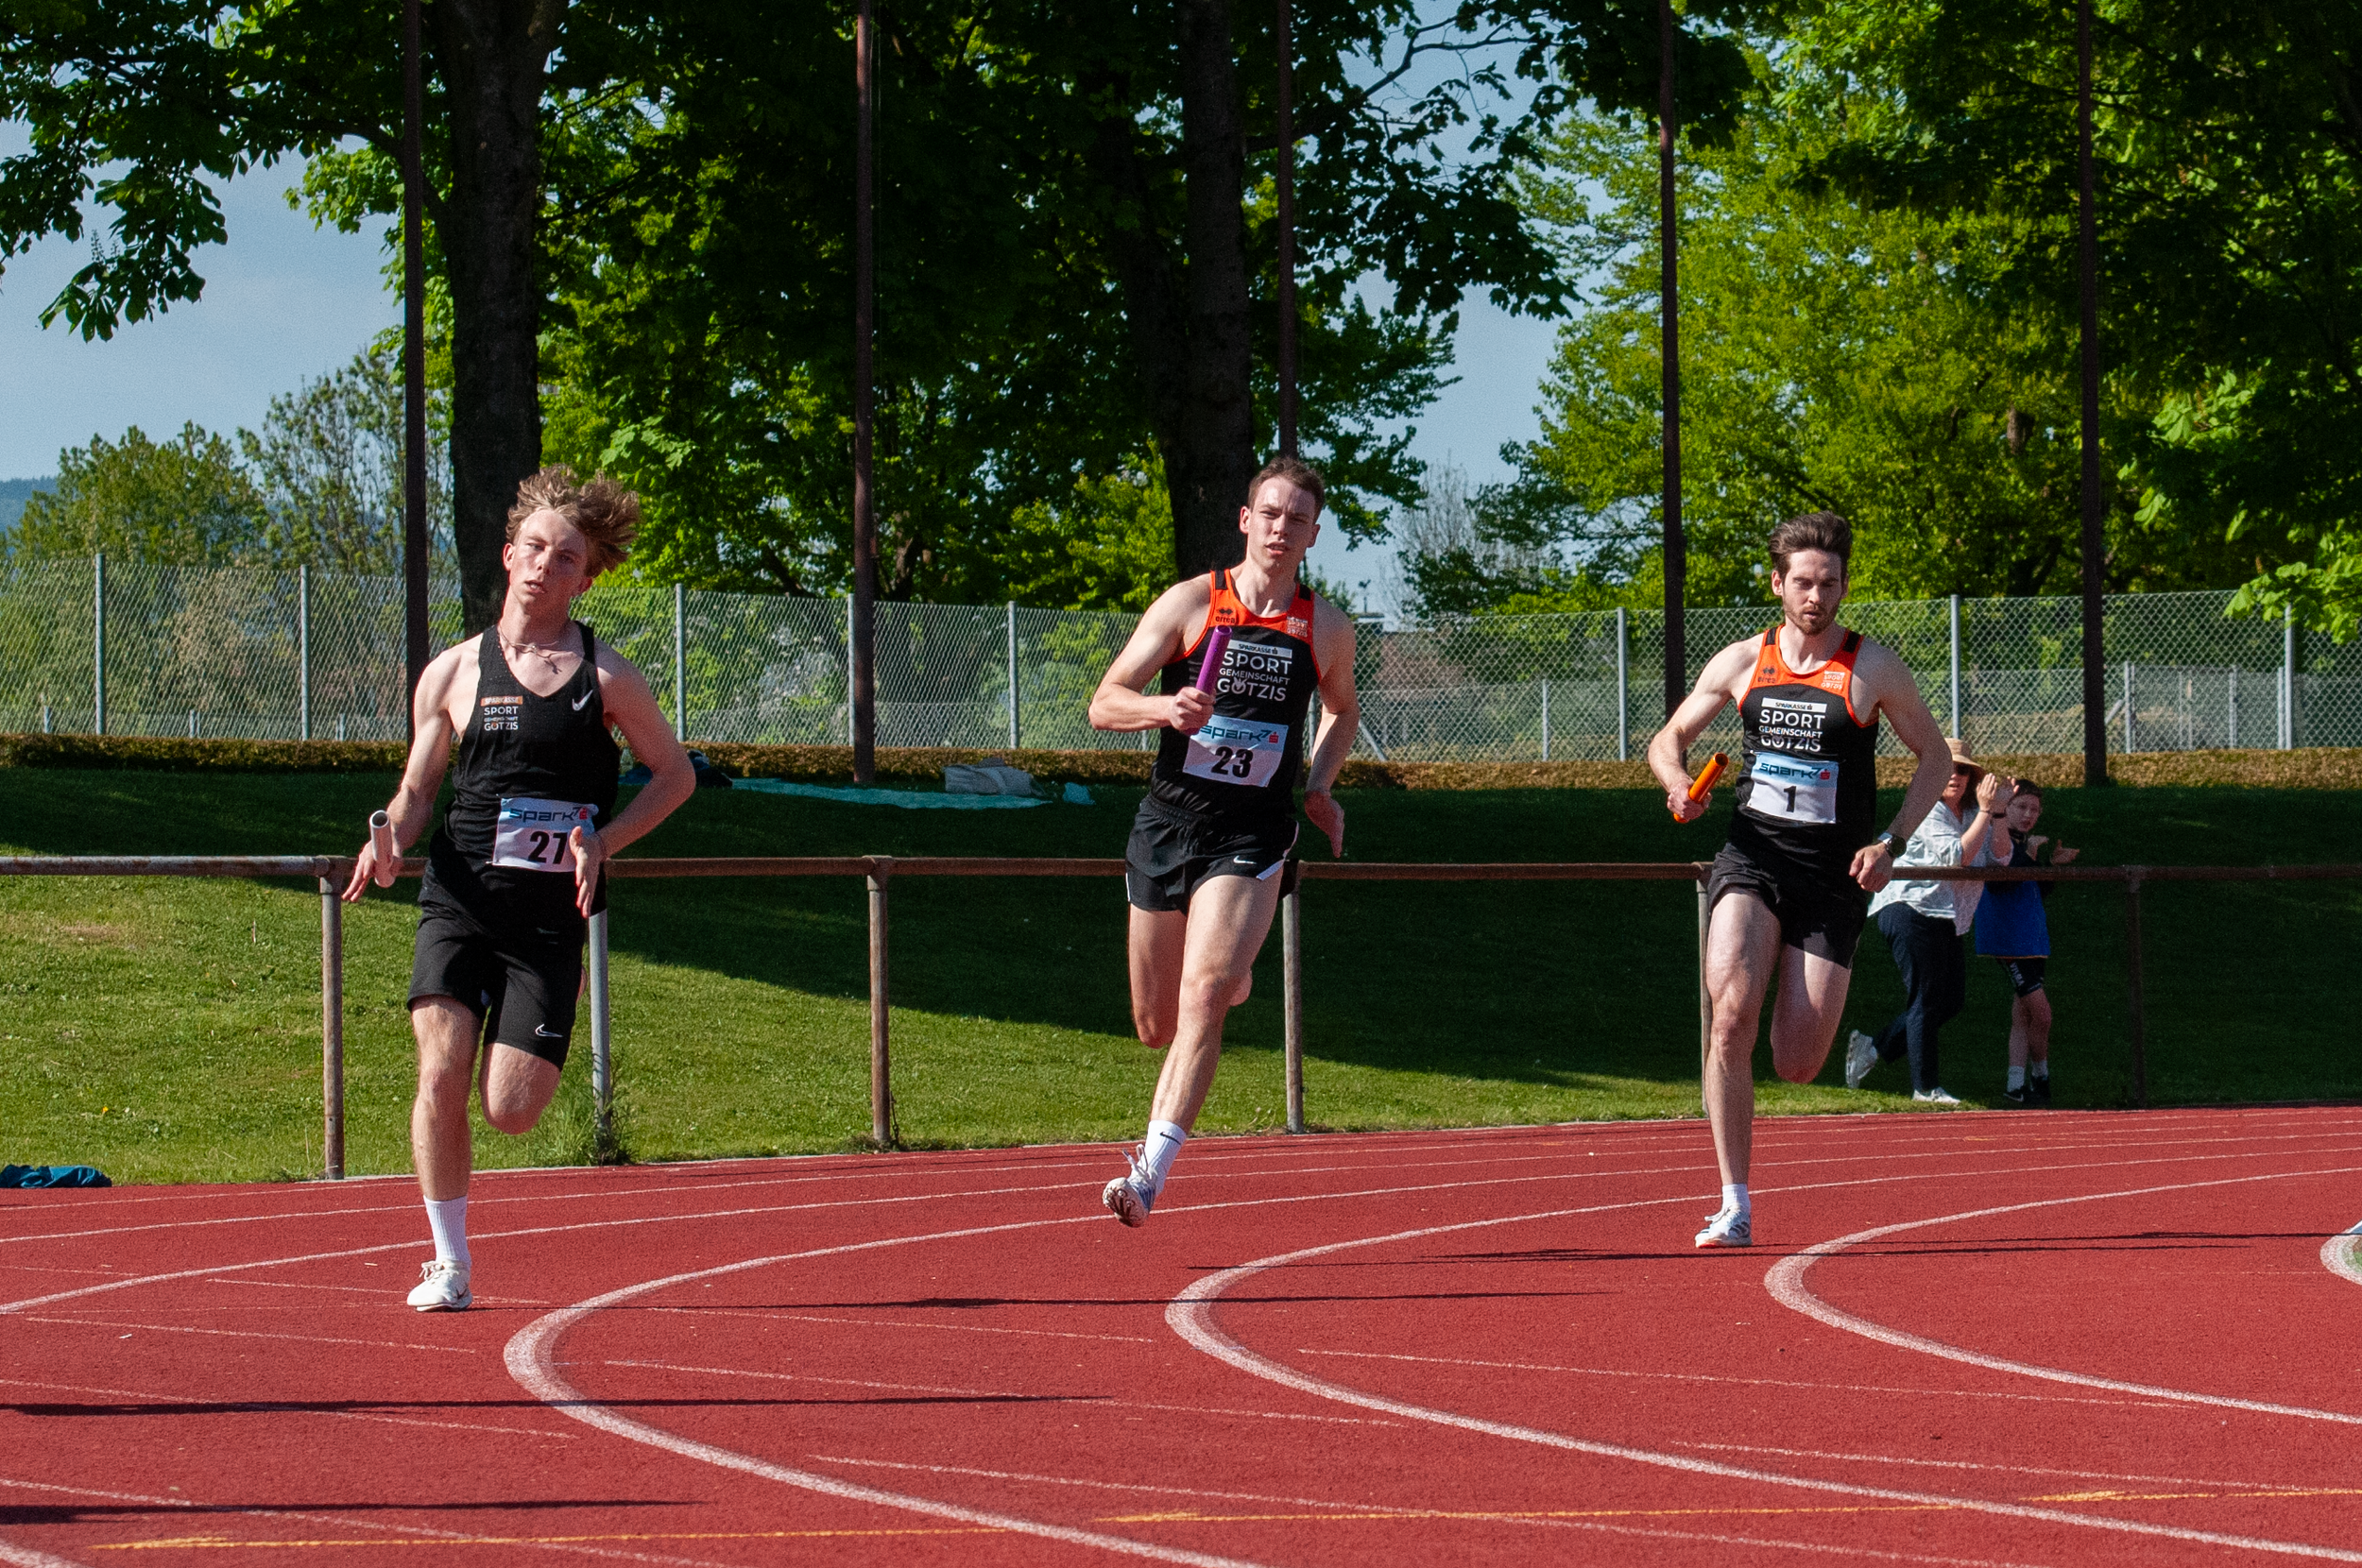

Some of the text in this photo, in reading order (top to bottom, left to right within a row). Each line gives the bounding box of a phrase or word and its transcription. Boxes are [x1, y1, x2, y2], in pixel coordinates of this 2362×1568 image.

[1238, 643, 1272, 654] SPARKASSE
[1222, 651, 1292, 675] SPORT
[1219, 668, 1291, 686] GEMEINSCHAFT
[484, 706, 519, 715] SPORT
[1775, 702, 1806, 710] SPARKASSE
[1759, 709, 1826, 729] SPORT
[1758, 725, 1823, 739] GEMEINSCHAFT
[1211, 745, 1254, 778] 23
[1783, 785, 1797, 813] 1
[527, 830, 568, 864] 27
